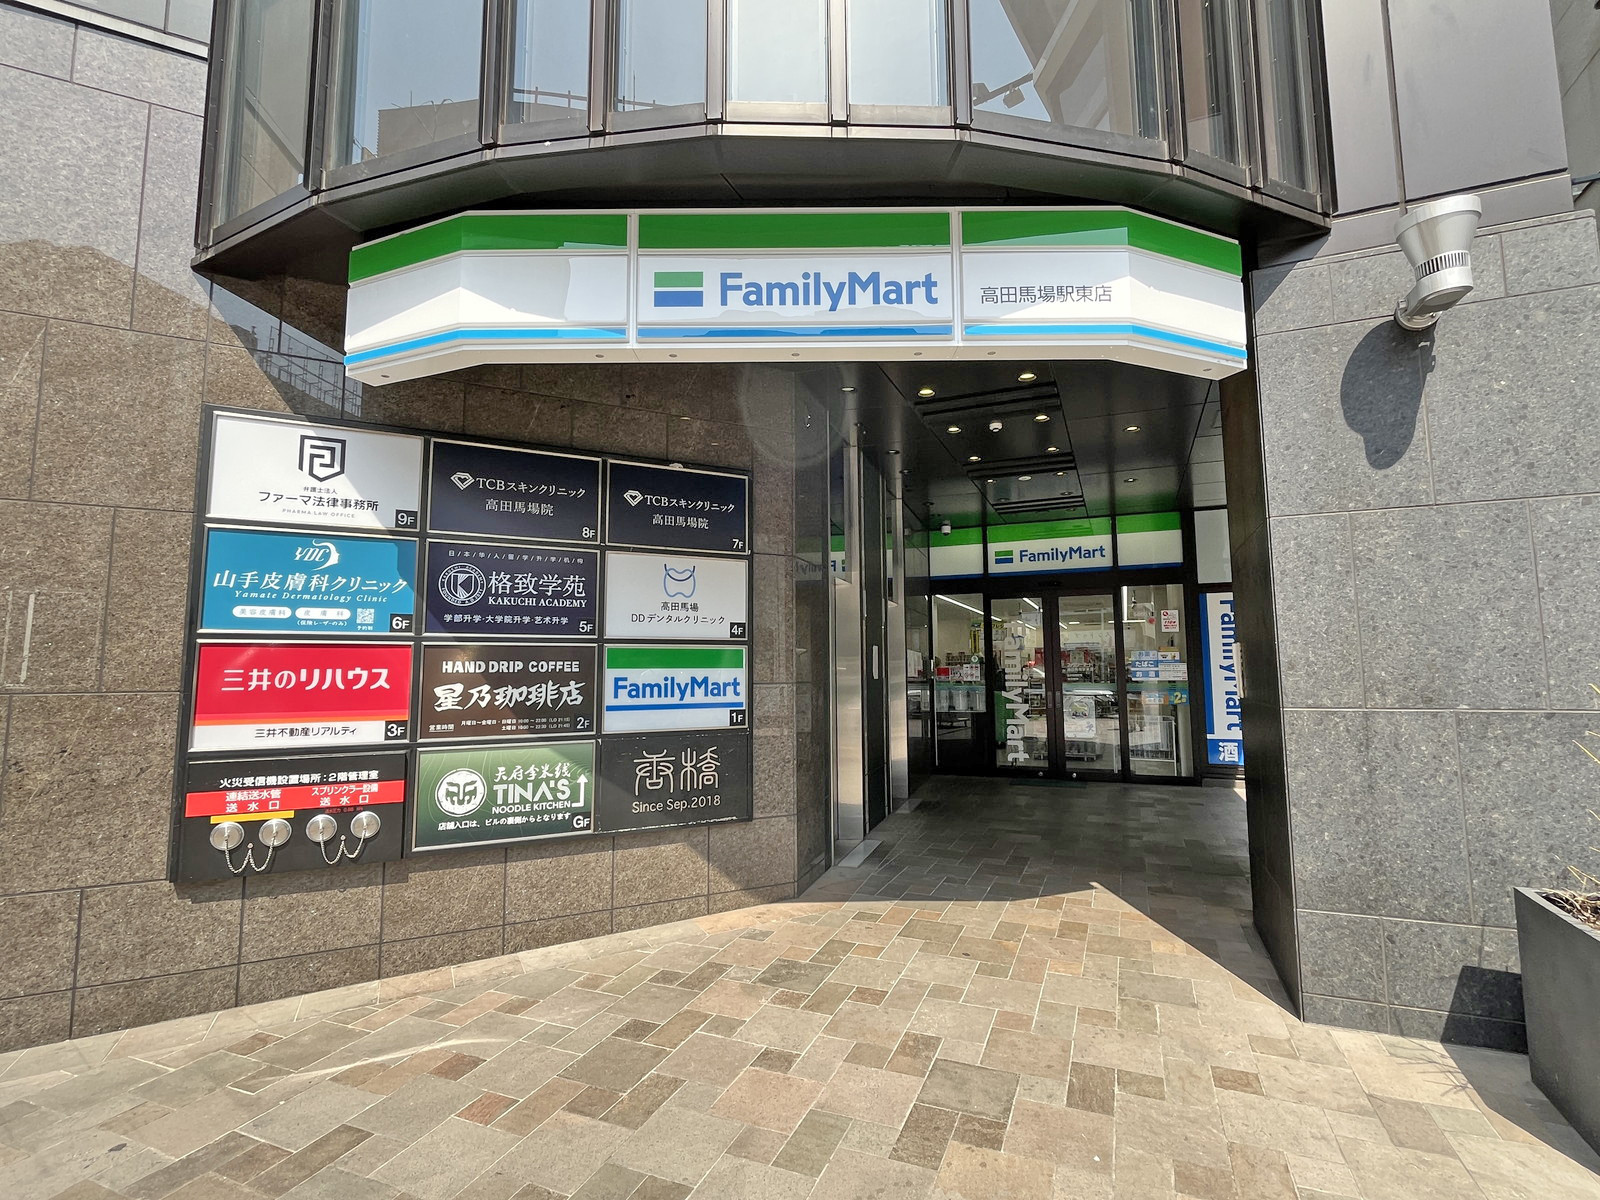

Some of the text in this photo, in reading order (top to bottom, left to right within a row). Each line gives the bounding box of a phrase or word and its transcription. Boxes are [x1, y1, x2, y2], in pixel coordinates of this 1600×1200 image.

[720, 272, 938, 312] FamilyMart
[980, 285, 1112, 304] 高田馬場駅東店
[303, 486, 338, 495] 弁護士法人
[476, 478, 586, 498] TCBスキンクリニック
[259, 491, 378, 512] ファーマ法律事務所
[485, 498, 554, 516] 高田馬場院
[644, 494, 734, 512] TCBスキンクリニック
[398, 513, 414, 526] 9F
[652, 514, 708, 529] 高田馬場院
[582, 527, 596, 538] 8F
[732, 539, 744, 549] 7F
[1019, 545, 1106, 562] FamilyMart
[212, 569, 408, 594] 山手皮膚科クリニック
[488, 571, 586, 597] 格致学苑
[234, 590, 388, 603] Yamate Dermatology Clinic
[488, 596, 588, 608] KAKUCHI ACADEMY
[660, 602, 698, 612] 高田馬場
[392, 616, 410, 630] 6F
[631, 614, 725, 624] DDデンタルクリニック
[579, 621, 593, 632] 5F
[731, 624, 744, 635] 4F
[442, 660, 580, 674] HAND DRIP COFFEE
[1135, 660, 1154, 668] たばこ
[221, 668, 390, 691] 三井のリハウス
[434, 680, 586, 712] 星乃珈琲店
[614, 676, 740, 702] FamilyMart
[1002, 623, 1030, 762] FamilyMart
[576, 717, 590, 729] 2F
[732, 712, 743, 723] 1F
[254, 726, 357, 738] 三井不動産リアルティ
[387, 724, 404, 737] 3F
[1218, 742, 1238, 762] 酒
[226, 790, 282, 802] 連結送水管
[312, 784, 378, 796] スプリンクラー設備
[493, 778, 571, 804] TINA'S
[492, 800, 571, 814] NOODLE KITCHEN
[632, 794, 720, 814] Since Sep.2018
[573, 816, 590, 828] GF
